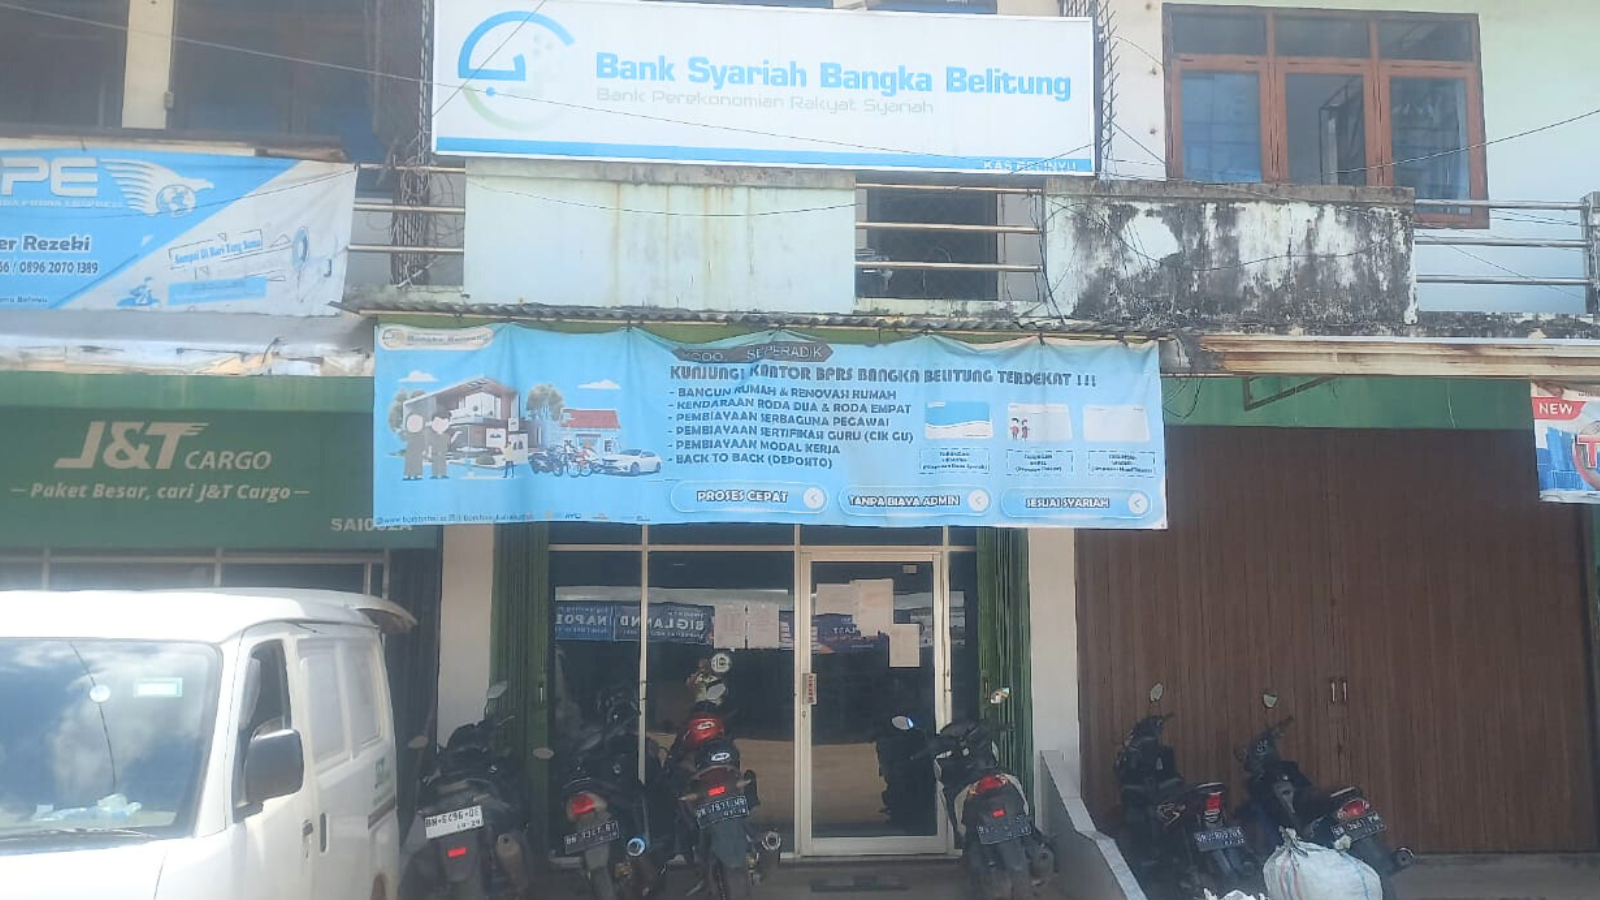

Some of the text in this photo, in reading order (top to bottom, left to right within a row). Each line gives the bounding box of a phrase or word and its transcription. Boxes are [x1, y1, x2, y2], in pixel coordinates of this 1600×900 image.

[596, 52, 1071, 102] Bank Syariah Bangka Belitung
[596, 87, 934, 115] Bank Perekonomian Rakyat Syariah
[983, 160, 1013, 170] KAS
[22, 234, 91, 251] Rezeki
[19, 261, 45, 273] 0896
[47, 261, 74, 273] 2070
[749, 364, 811, 380] KANTOR
[816, 367, 853, 381] BPRS
[858, 368, 919, 383] BANGKA
[924, 369, 993, 383] BELITUNG
[997, 370, 1072, 386] TERDEKAT
[678, 385, 896, 400] BANGUN RUMAH & RENOVASI RUMAH
[677, 398, 911, 414] KENDARAAN RODA DUA & RODA EMPAT
[1538, 403, 1573, 415] NEW
[676, 411, 889, 427] PEMBIAYAAN SERBAGUNA PEGAWAI
[676, 425, 913, 444] PEMBIAYAAN SERTIFIKASI GURU (CIK GU)
[54, 421, 272, 470] J&T CARGO
[676, 439, 841, 454] PEMBIAYAAN MODAL KERJA
[676, 452, 832, 469] BACK TO BACK (DEPOSITO)
[31, 483, 290, 503] Paket Besar, cari J&T Cargo
[696, 490, 788, 503] PROSES CEPAT
[849, 494, 960, 507] TANPA BIAYA ADMIN
[1026, 497, 1110, 508] SESUAI SYARIAH
